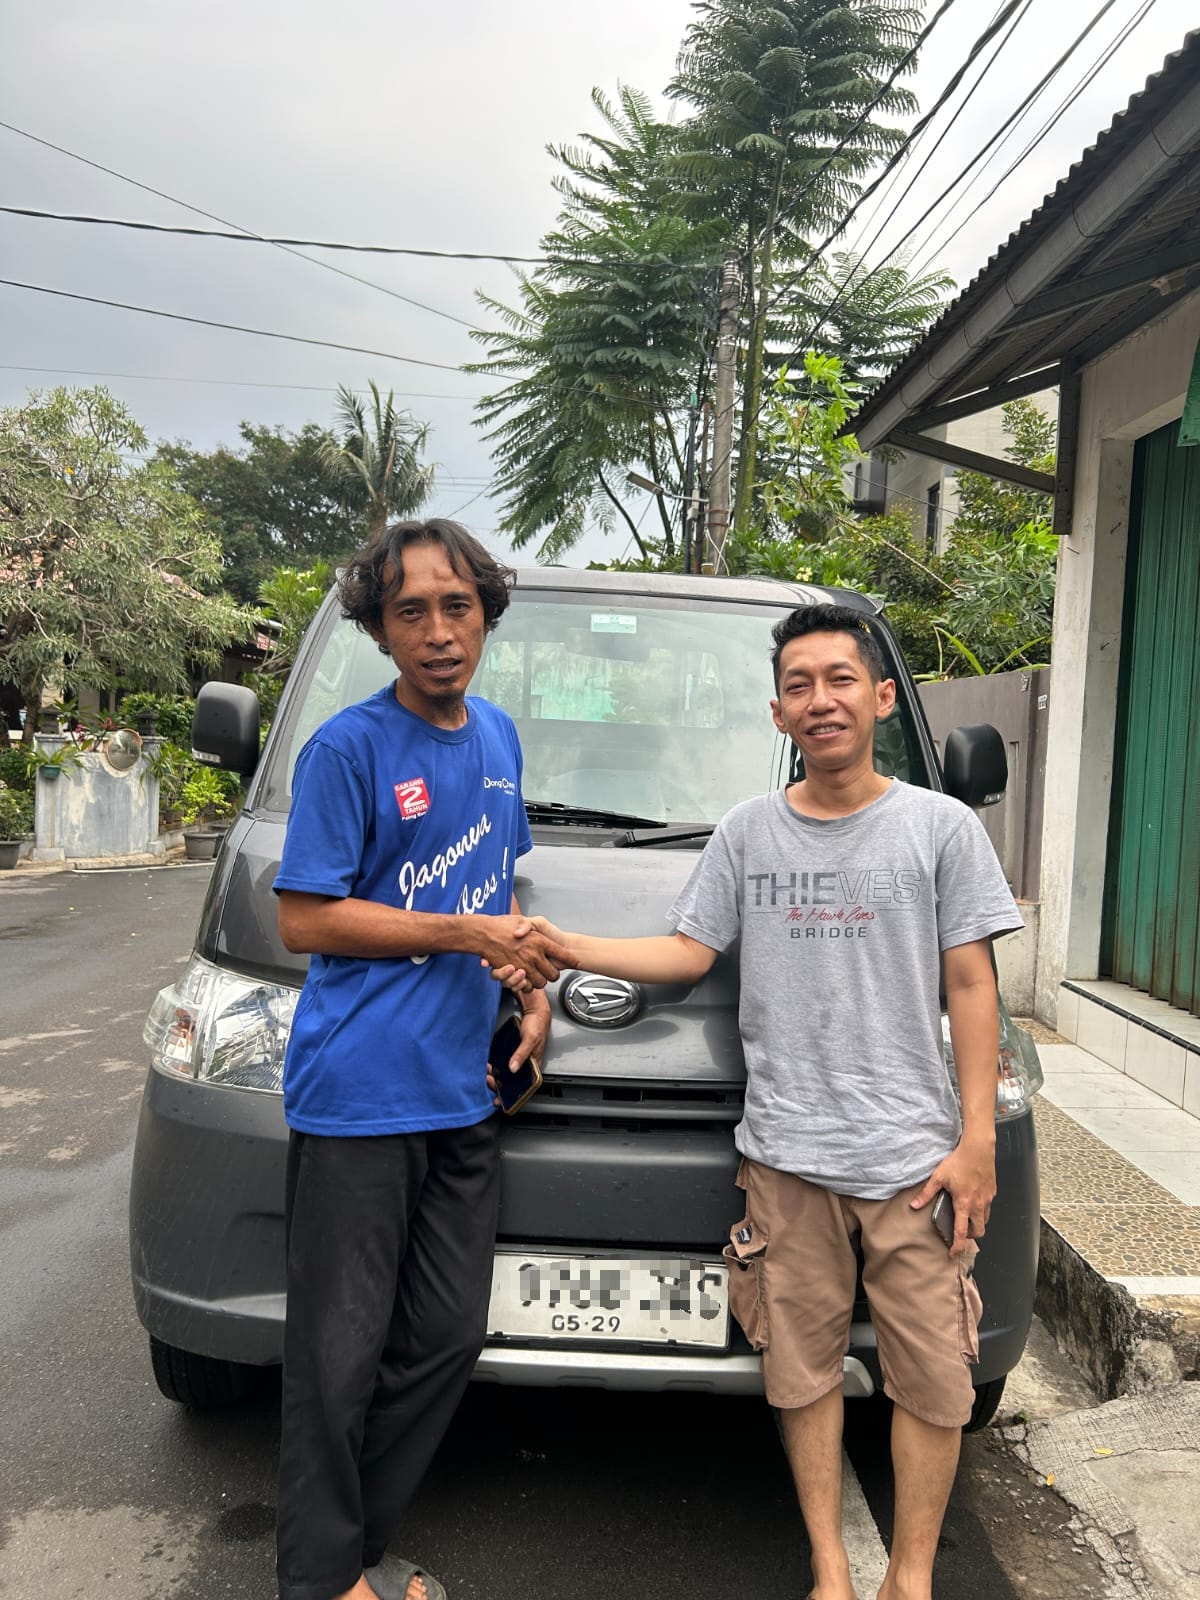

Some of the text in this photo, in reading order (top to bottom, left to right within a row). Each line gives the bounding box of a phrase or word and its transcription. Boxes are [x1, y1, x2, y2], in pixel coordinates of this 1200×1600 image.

[400, 786, 426, 809] 2
[747, 869, 922, 906] THIEVES
[784, 906, 804, 925] The
[790, 926, 868, 939] BRIDGE
